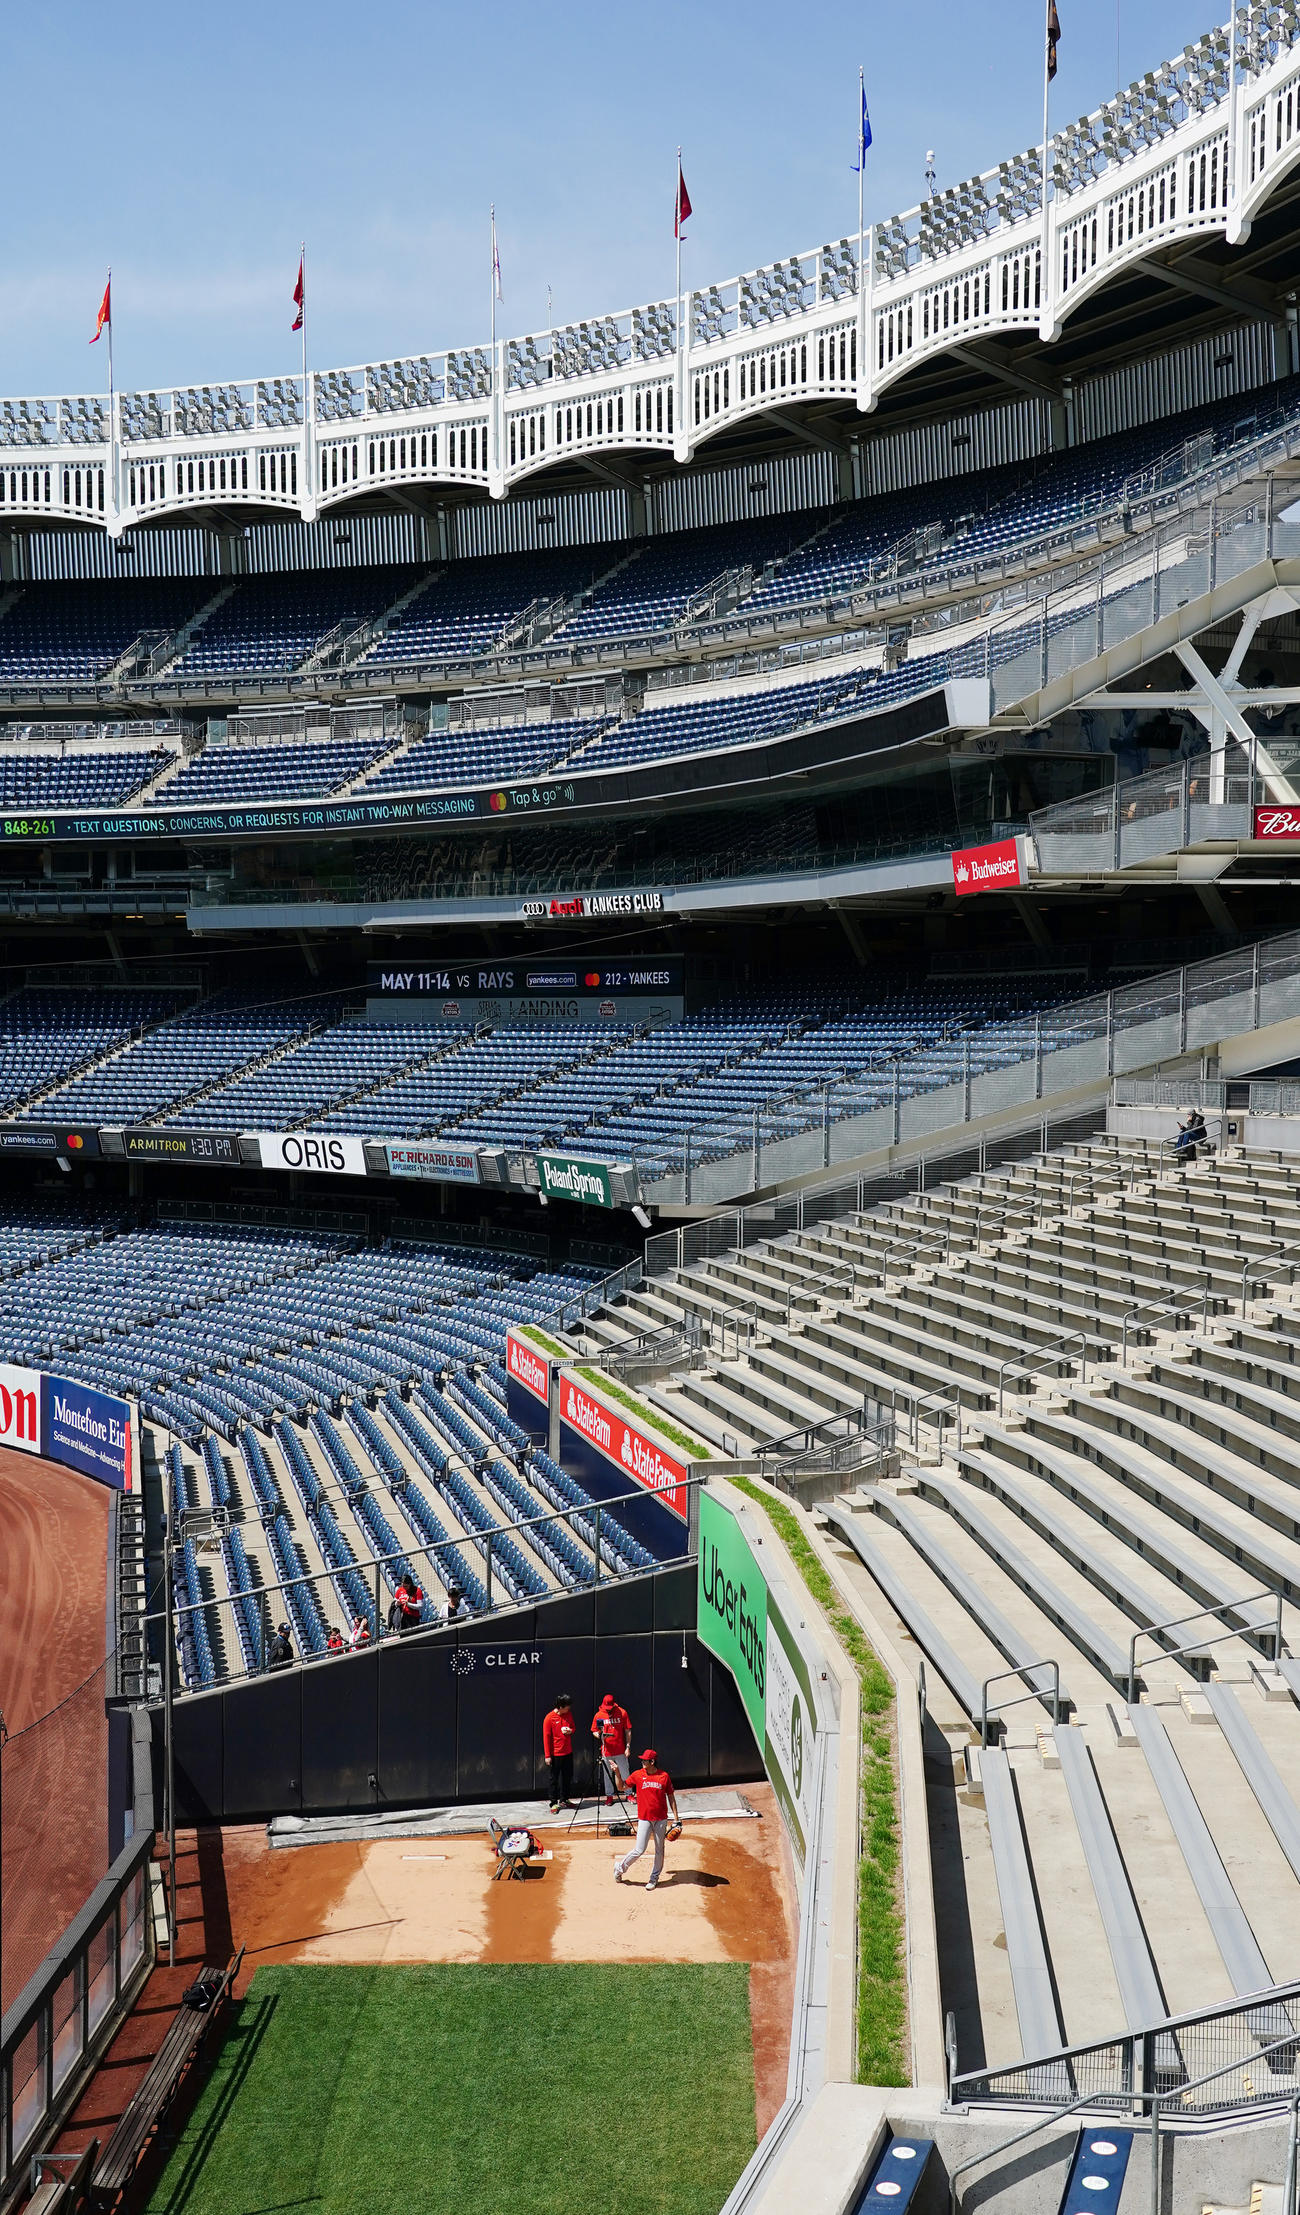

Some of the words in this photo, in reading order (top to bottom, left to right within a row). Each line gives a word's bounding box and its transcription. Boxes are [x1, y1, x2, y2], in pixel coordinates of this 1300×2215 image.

[509, 791, 530, 808] Tap
[531, 787, 541, 803] &
[73, 821, 100, 833] TEXT
[103, 818, 168, 833] QUESTIONS,
[169, 816, 227, 830] CONCERNS,
[228, 815, 243, 828] OR
[246, 812, 300, 827] REQUESTS
[302, 811, 325, 824] FOR
[326, 808, 366, 823] INSTANT
[367, 803, 414, 819] TWO-WAY
[416, 798, 475, 816] MESSAGING
[4, 819, 56, 834] 848-261
[971, 857, 1017, 881] Budweiser
[549, 898, 583, 915] Audi
[585, 895, 632, 913] YANKEES
[633, 893, 662, 910] CLUB
[381, 973, 414, 990] MAY
[417, 973, 451, 990] 11-14
[456, 975, 470, 988] VS
[478, 971, 515, 989] RAYS
[528, 976, 575, 985] yankees.com
[605, 973, 622, 985] 212
[628, 971, 671, 985] YANKEES
[509, 1000, 579, 1016] LANDING
[2, 1136, 54, 1146] yankees.com
[129, 1138, 187, 1152] ARMITRON
[191, 1138, 212, 1155] 1:30
[216, 1139, 232, 1157] PM
[281, 1137, 346, 1171] ORIS
[406, 1151, 448, 1166] RICHARD
[448, 1155, 455, 1167] &
[455, 1156, 473, 1169] SON
[542, 1160, 574, 1190] Poland
[570, 1164, 605, 1203] Spring
[53, 1395, 108, 1442] Montefiore
[53, 1430, 71, 1446] Science
[70, 1439, 79, 1450] and
[703, 1535, 738, 1638] Uber
[739, 1581, 765, 1700] Eats
[485, 1652, 540, 1666] CLEAR
